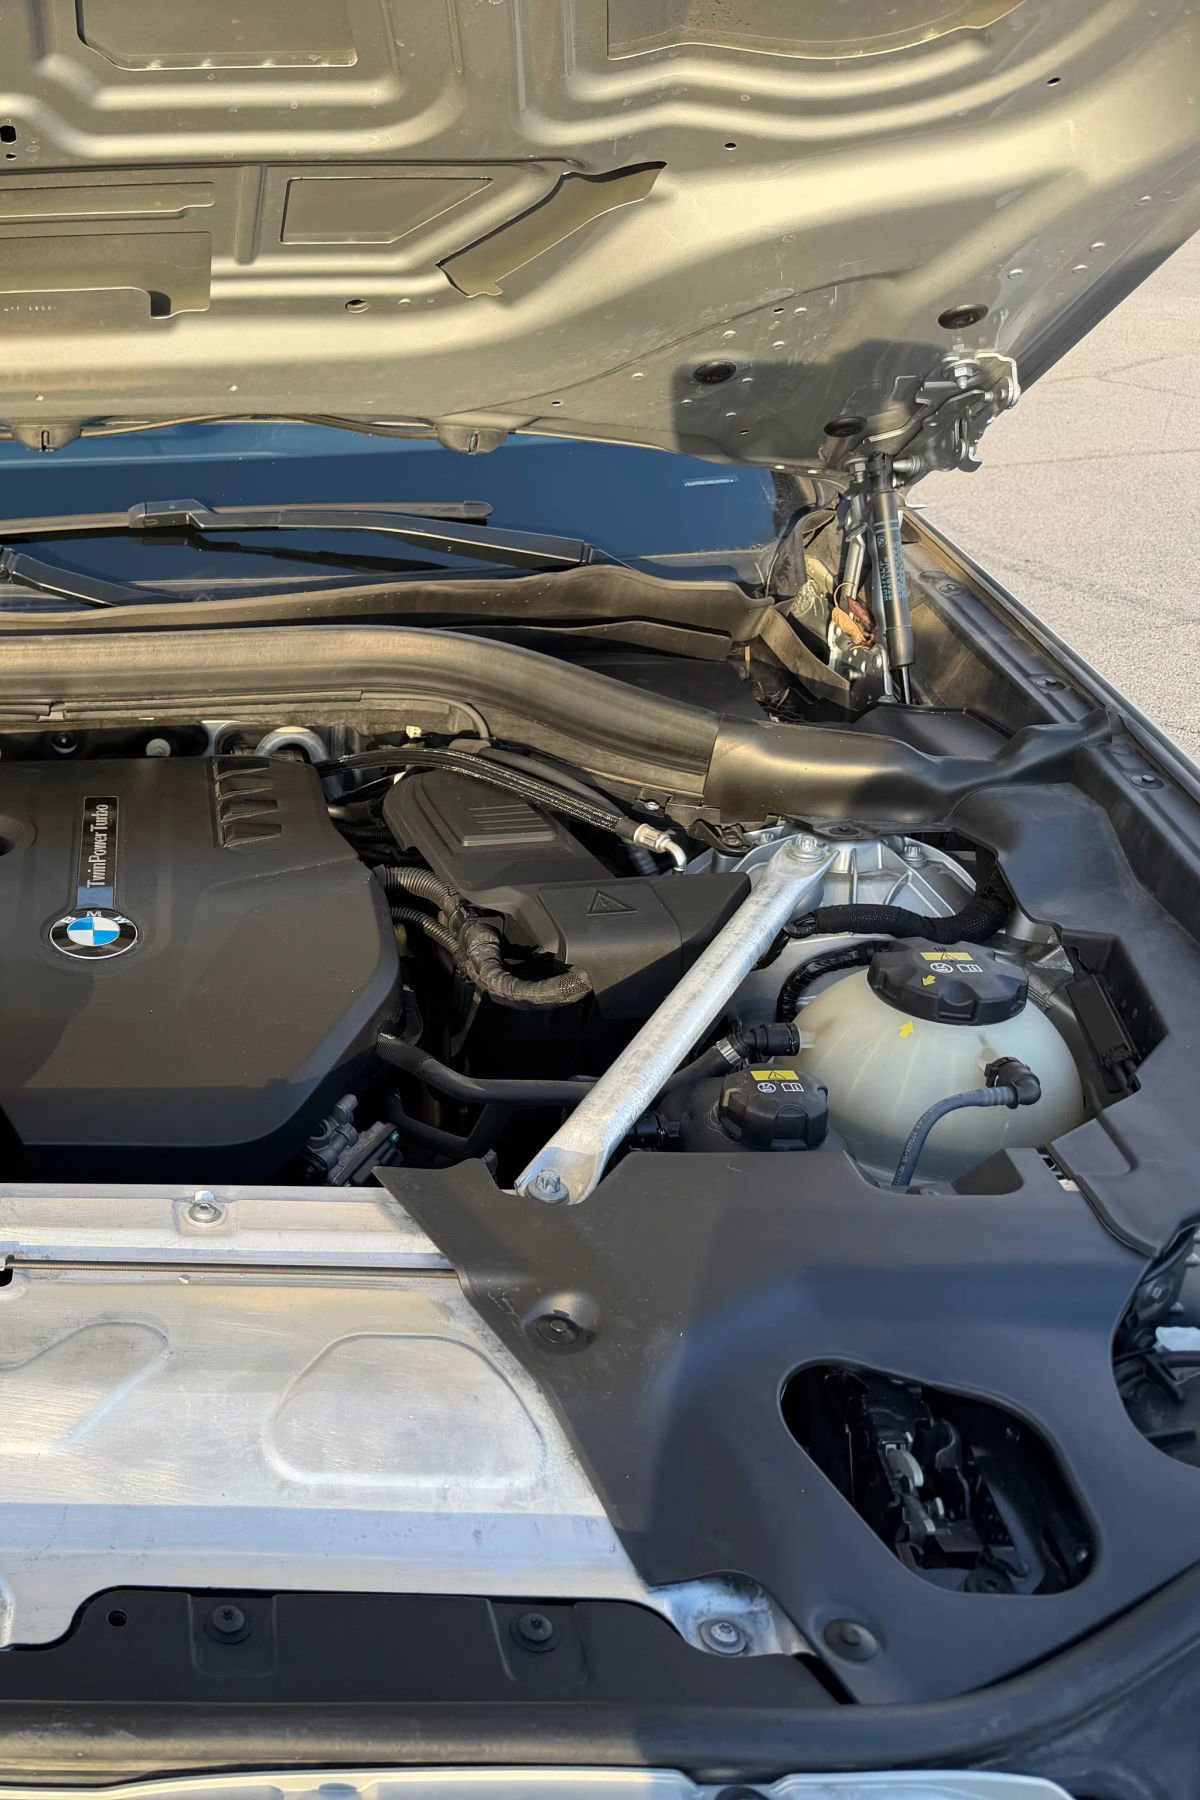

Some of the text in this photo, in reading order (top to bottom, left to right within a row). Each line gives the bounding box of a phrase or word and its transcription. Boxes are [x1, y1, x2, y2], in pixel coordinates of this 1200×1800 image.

[87, 804, 109, 888] TwinPower Turbo
[60, 910, 131, 924] BMW
